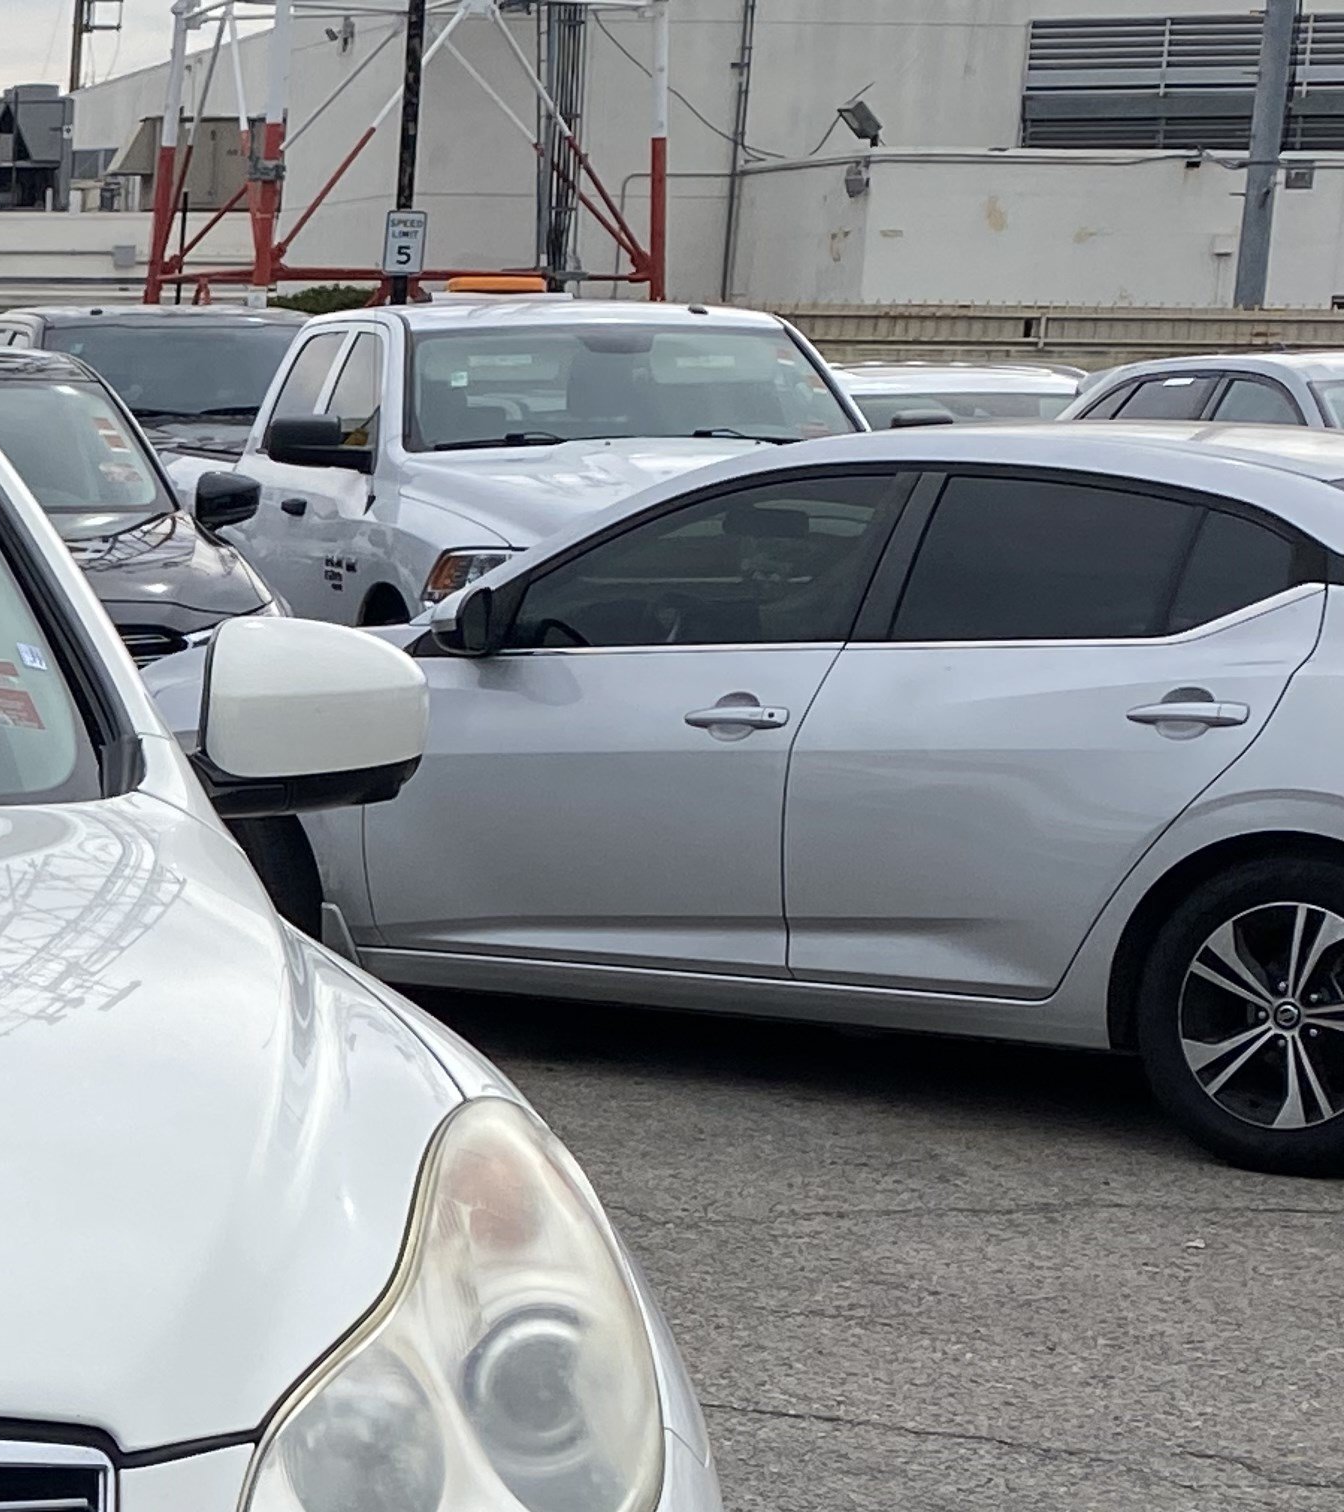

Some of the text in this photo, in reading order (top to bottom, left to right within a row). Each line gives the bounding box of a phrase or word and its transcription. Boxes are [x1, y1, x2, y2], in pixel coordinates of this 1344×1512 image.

[390, 218, 424, 228] SPEED
[392, 230, 420, 239] LIMIT
[396, 245, 411, 265] 5
